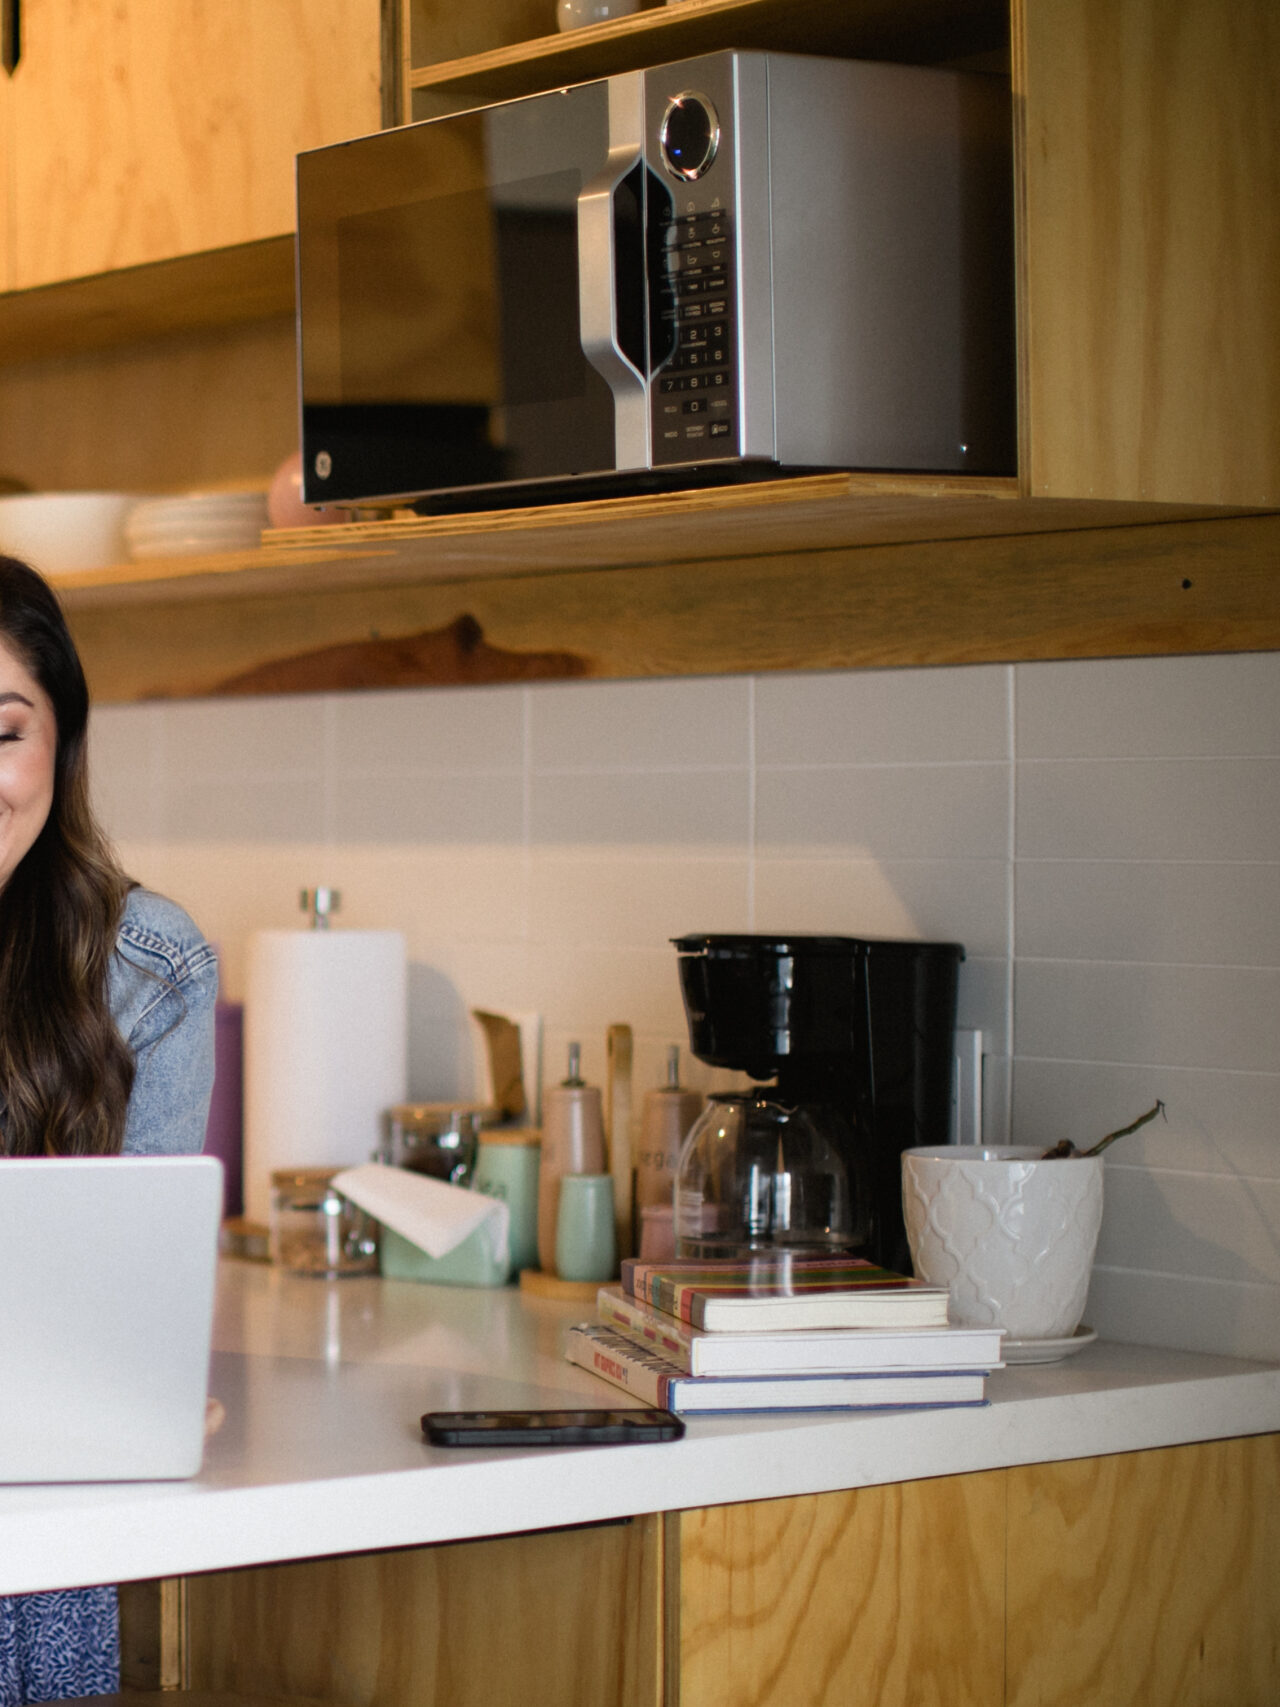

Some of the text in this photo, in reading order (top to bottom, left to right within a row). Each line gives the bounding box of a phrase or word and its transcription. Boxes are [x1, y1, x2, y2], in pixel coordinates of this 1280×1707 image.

[690, 327, 721, 340] 2 3
[690, 354, 697, 363] 5
[666, 375, 722, 391] 7 8 9
[691, 402, 698, 412] 0
